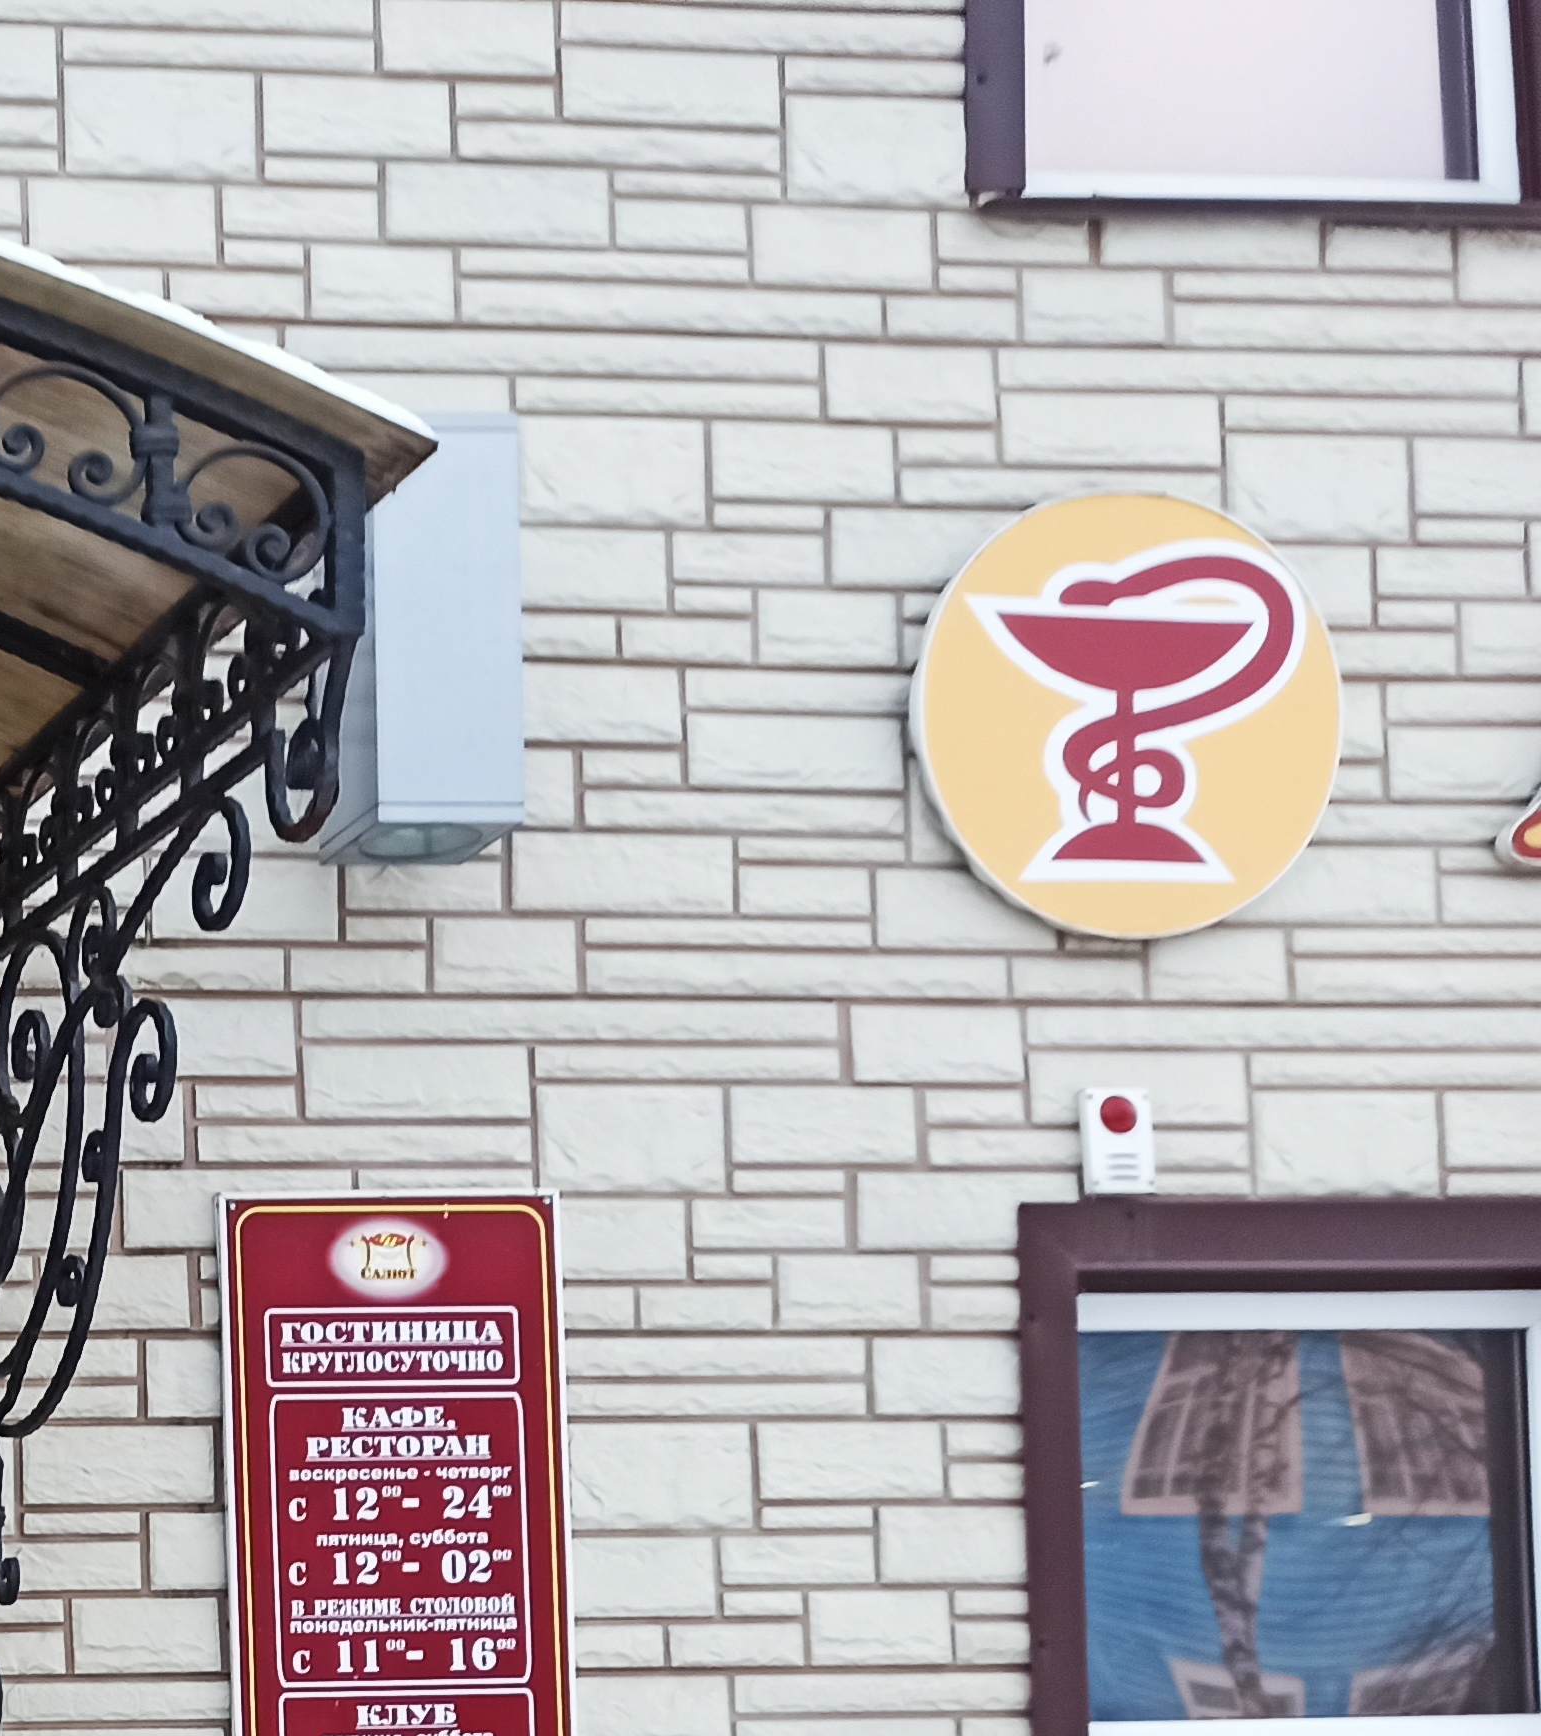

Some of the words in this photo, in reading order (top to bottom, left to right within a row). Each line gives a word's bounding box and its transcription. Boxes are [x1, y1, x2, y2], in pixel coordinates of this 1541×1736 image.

[281, 1321, 503, 1346] ГОСТИНИЦА
[281, 1350, 504, 1374] КРУГЛОСУТОЧНО
[306, 1435, 491, 1461] РЕСТОРАН
[289, 1466, 419, 1483] воскресенье
[436, 1465, 512, 1482] четверг
[316, 1531, 404, 1548] пятница,
[409, 1528, 489, 1548] суббота
[291, 1599, 305, 1617] В
[314, 1598, 402, 1616] РЕЖИМЕ
[410, 1593, 516, 1616] СТОЛОВОЙ
[290, 1617, 518, 1635] понедельник-пятница
[356, 1703, 458, 1730] КЛУБ
